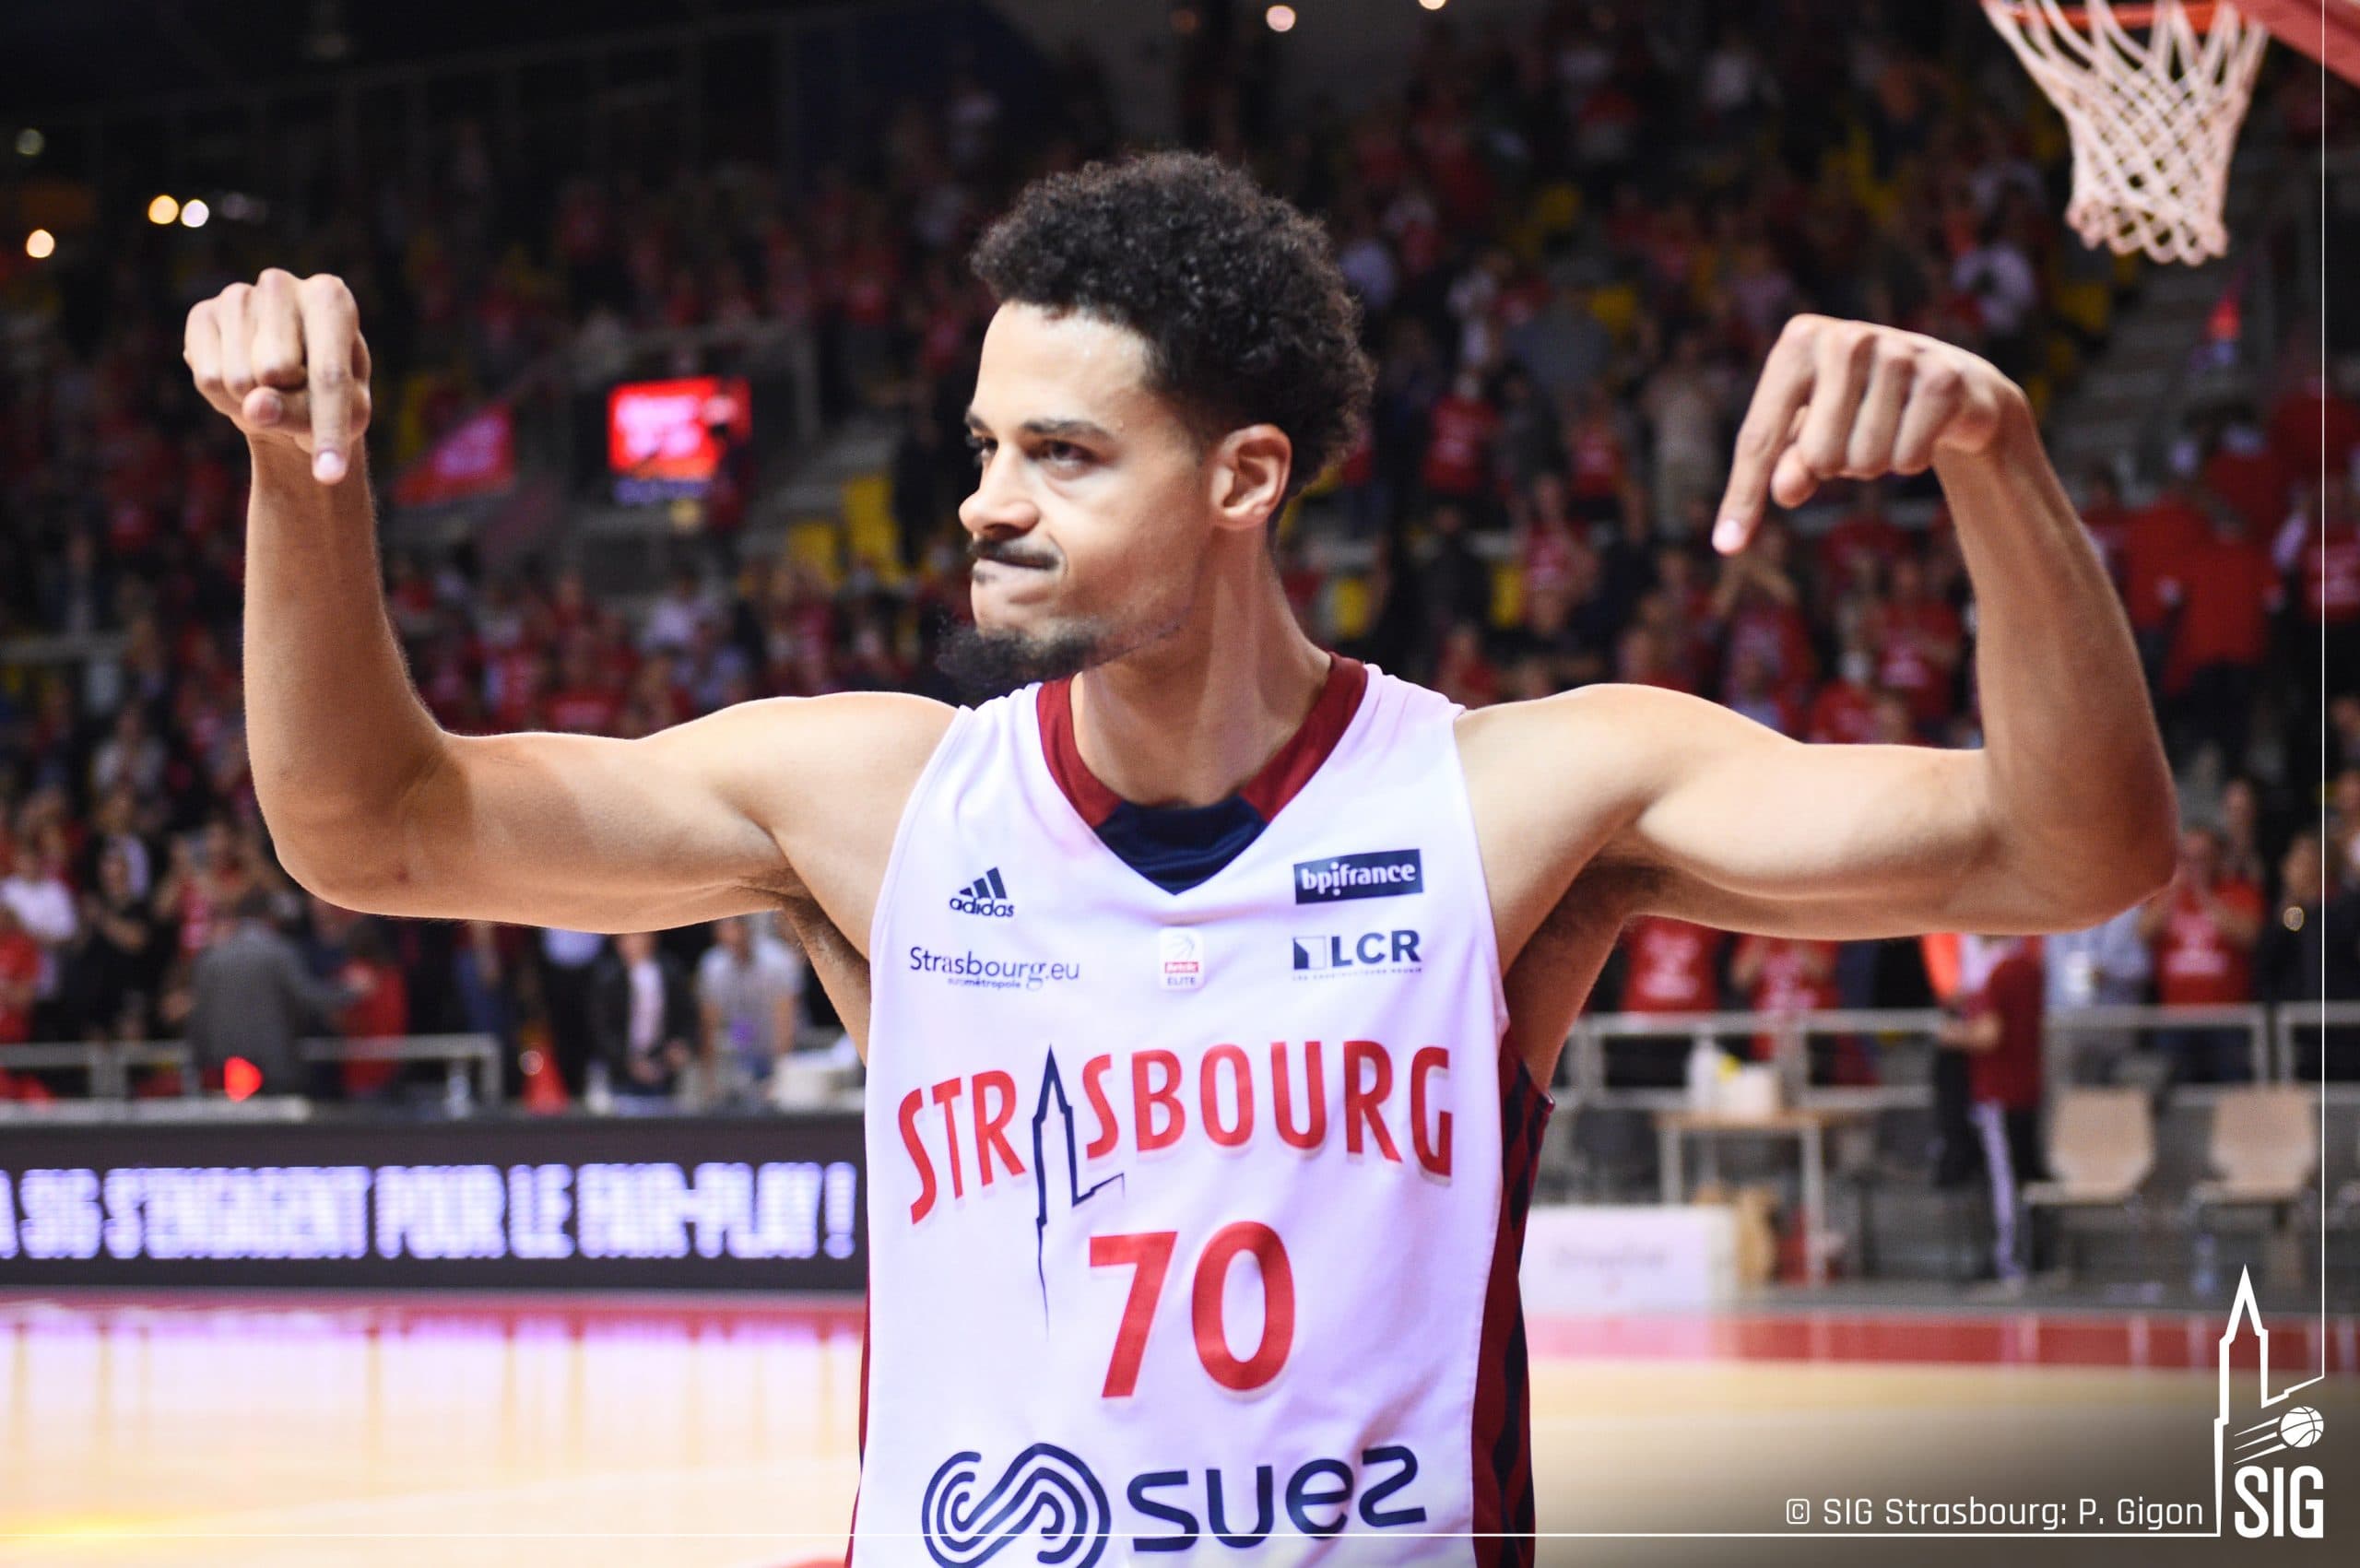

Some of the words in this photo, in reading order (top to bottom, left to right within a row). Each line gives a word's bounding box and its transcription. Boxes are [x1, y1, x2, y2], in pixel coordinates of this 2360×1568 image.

[1300, 861, 1417, 896] bpifrance
[949, 896, 1015, 918] adidas
[910, 946, 1080, 992] Strasbourg.eu
[1331, 929, 1422, 969] LCR
[508, 1163, 575, 1259] LE
[1090, 1220, 1295, 1399] 70
